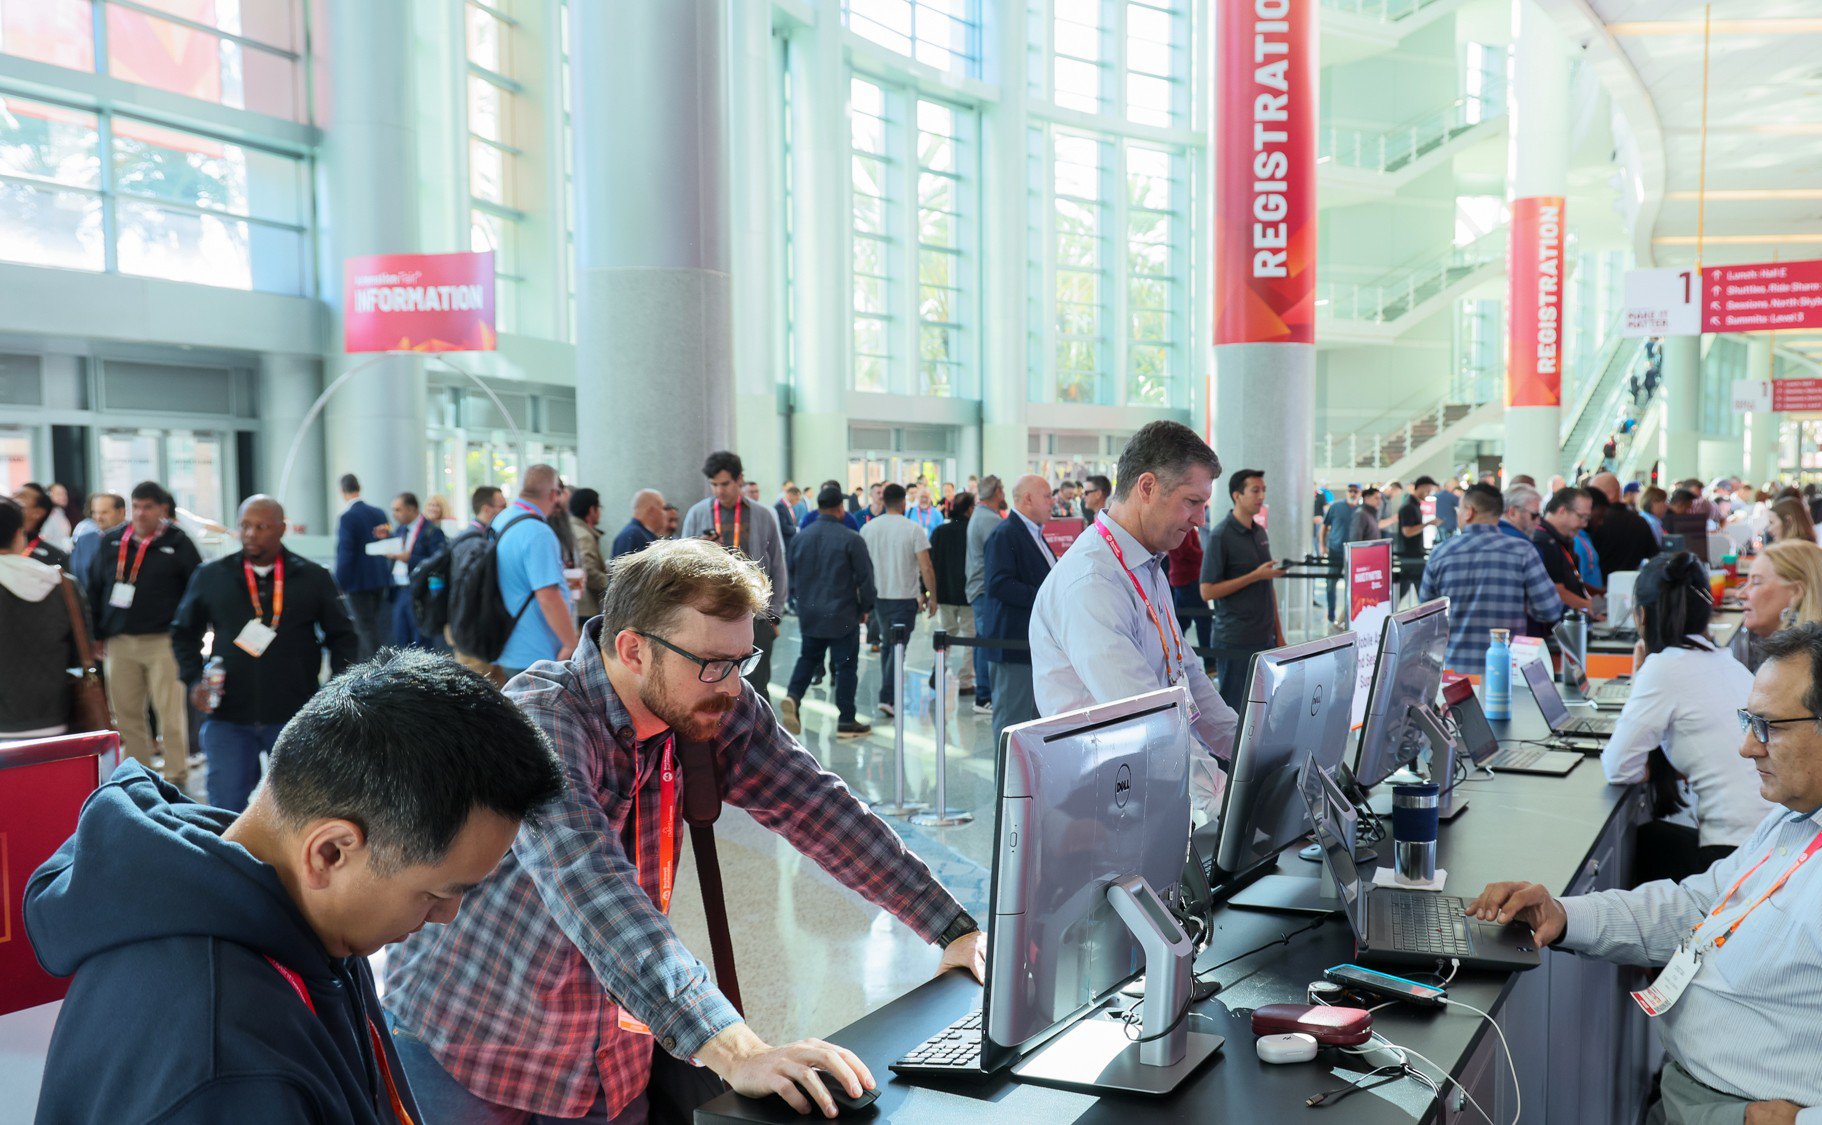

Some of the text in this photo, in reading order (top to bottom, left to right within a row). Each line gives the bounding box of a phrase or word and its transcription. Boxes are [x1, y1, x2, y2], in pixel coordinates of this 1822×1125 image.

[1253, 0, 1290, 278] REGISTRATIO
[355, 285, 483, 312] INFORMATION
[1536, 205, 1560, 374] REGISTRATION
[1679, 271, 1691, 304] 1
